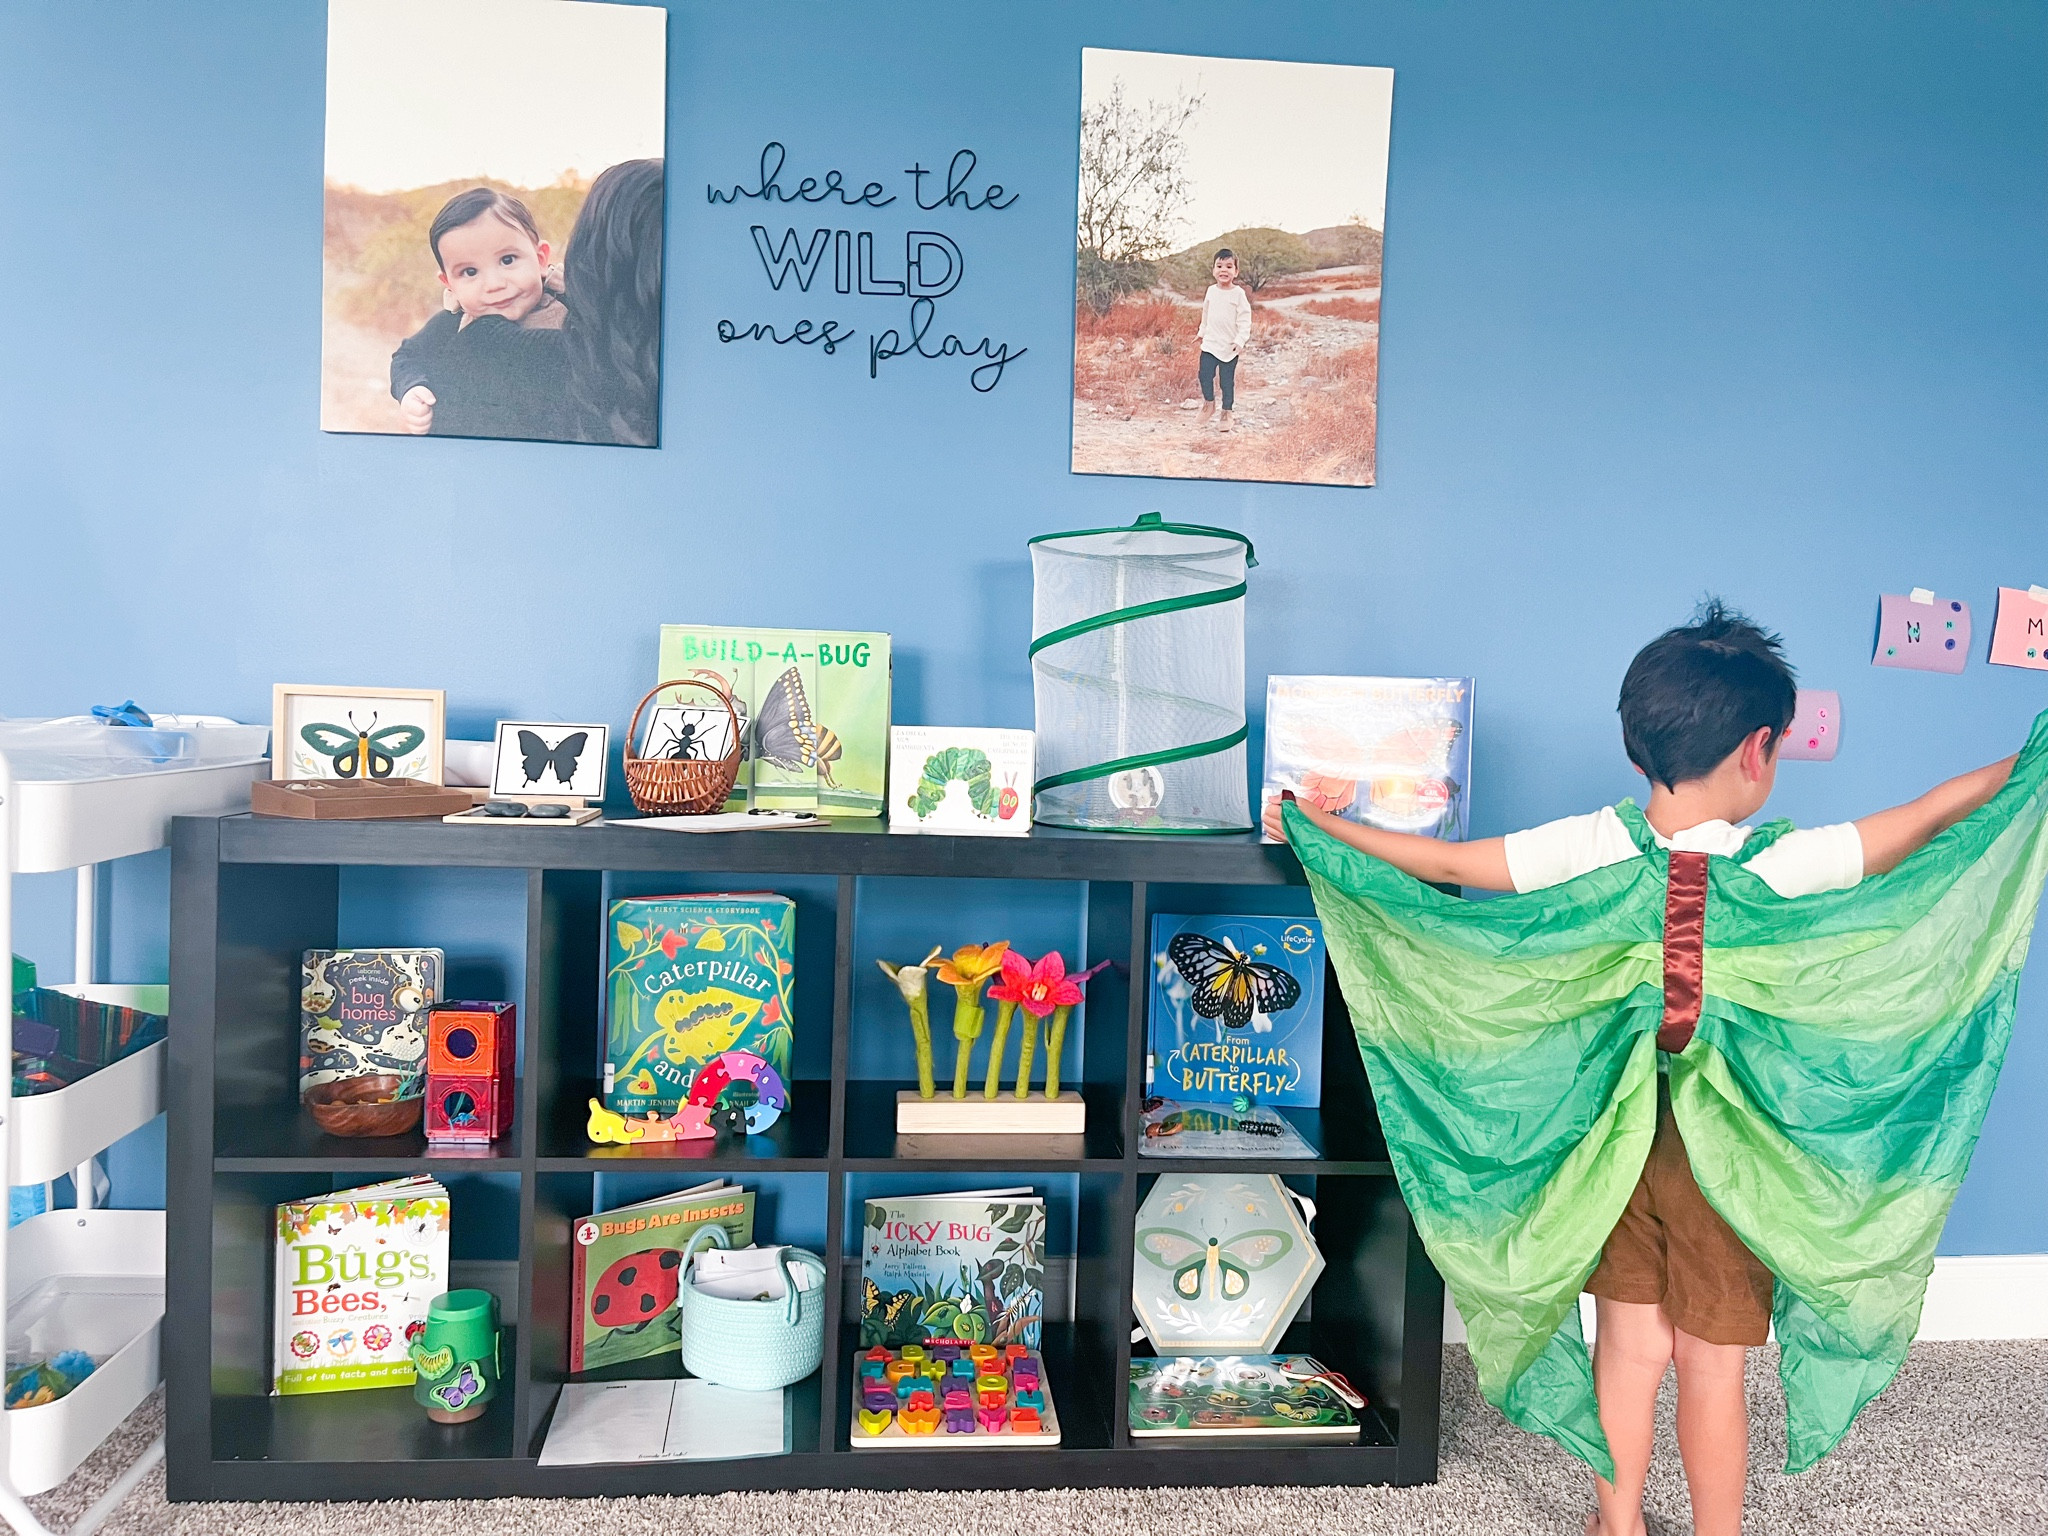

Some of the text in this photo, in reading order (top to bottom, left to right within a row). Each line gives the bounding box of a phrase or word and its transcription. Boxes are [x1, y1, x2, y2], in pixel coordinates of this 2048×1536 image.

[708, 142, 1019, 210] where the
[750, 225, 963, 298] WILD
[718, 298, 1028, 392] ones play
[2028, 618, 2043, 636] M
[681, 635, 871, 667] BUILD-A-BUG
[1281, 935, 1316, 944] LifeCycles
[348, 975, 389, 985] peek inside
[644, 960, 772, 995] Caterpillar
[352, 986, 385, 1009] bug
[341, 1002, 396, 1021] homes
[1226, 1036, 1250, 1045] From
[1181, 1042, 1289, 1067] CATERPILLAR
[654, 1060, 695, 1089] and
[1229, 1064, 1239, 1073] to
[1182, 1067, 1287, 1096] BUTTERFLY
[648, 1098, 680, 1106] JENKINS
[601, 1201, 745, 1238] Bugs Are Insects
[890, 1211, 905, 1219] The
[584, 1226, 593, 1240] 1
[884, 1220, 994, 1245] ICKY BUG
[886, 1243, 961, 1260] Alphabet Book
[292, 1289, 387, 1316] Bees,
[323, 1316, 345, 1324] Buzzy
[348, 1313, 389, 1322] Creatures
[931, 1338, 975, 1346] SCHOLASTIC
[284, 1373, 302, 1383] Full
[306, 1373, 317, 1382] of
[340, 1370, 366, 1379] facts
[370, 1367, 387, 1377] and
